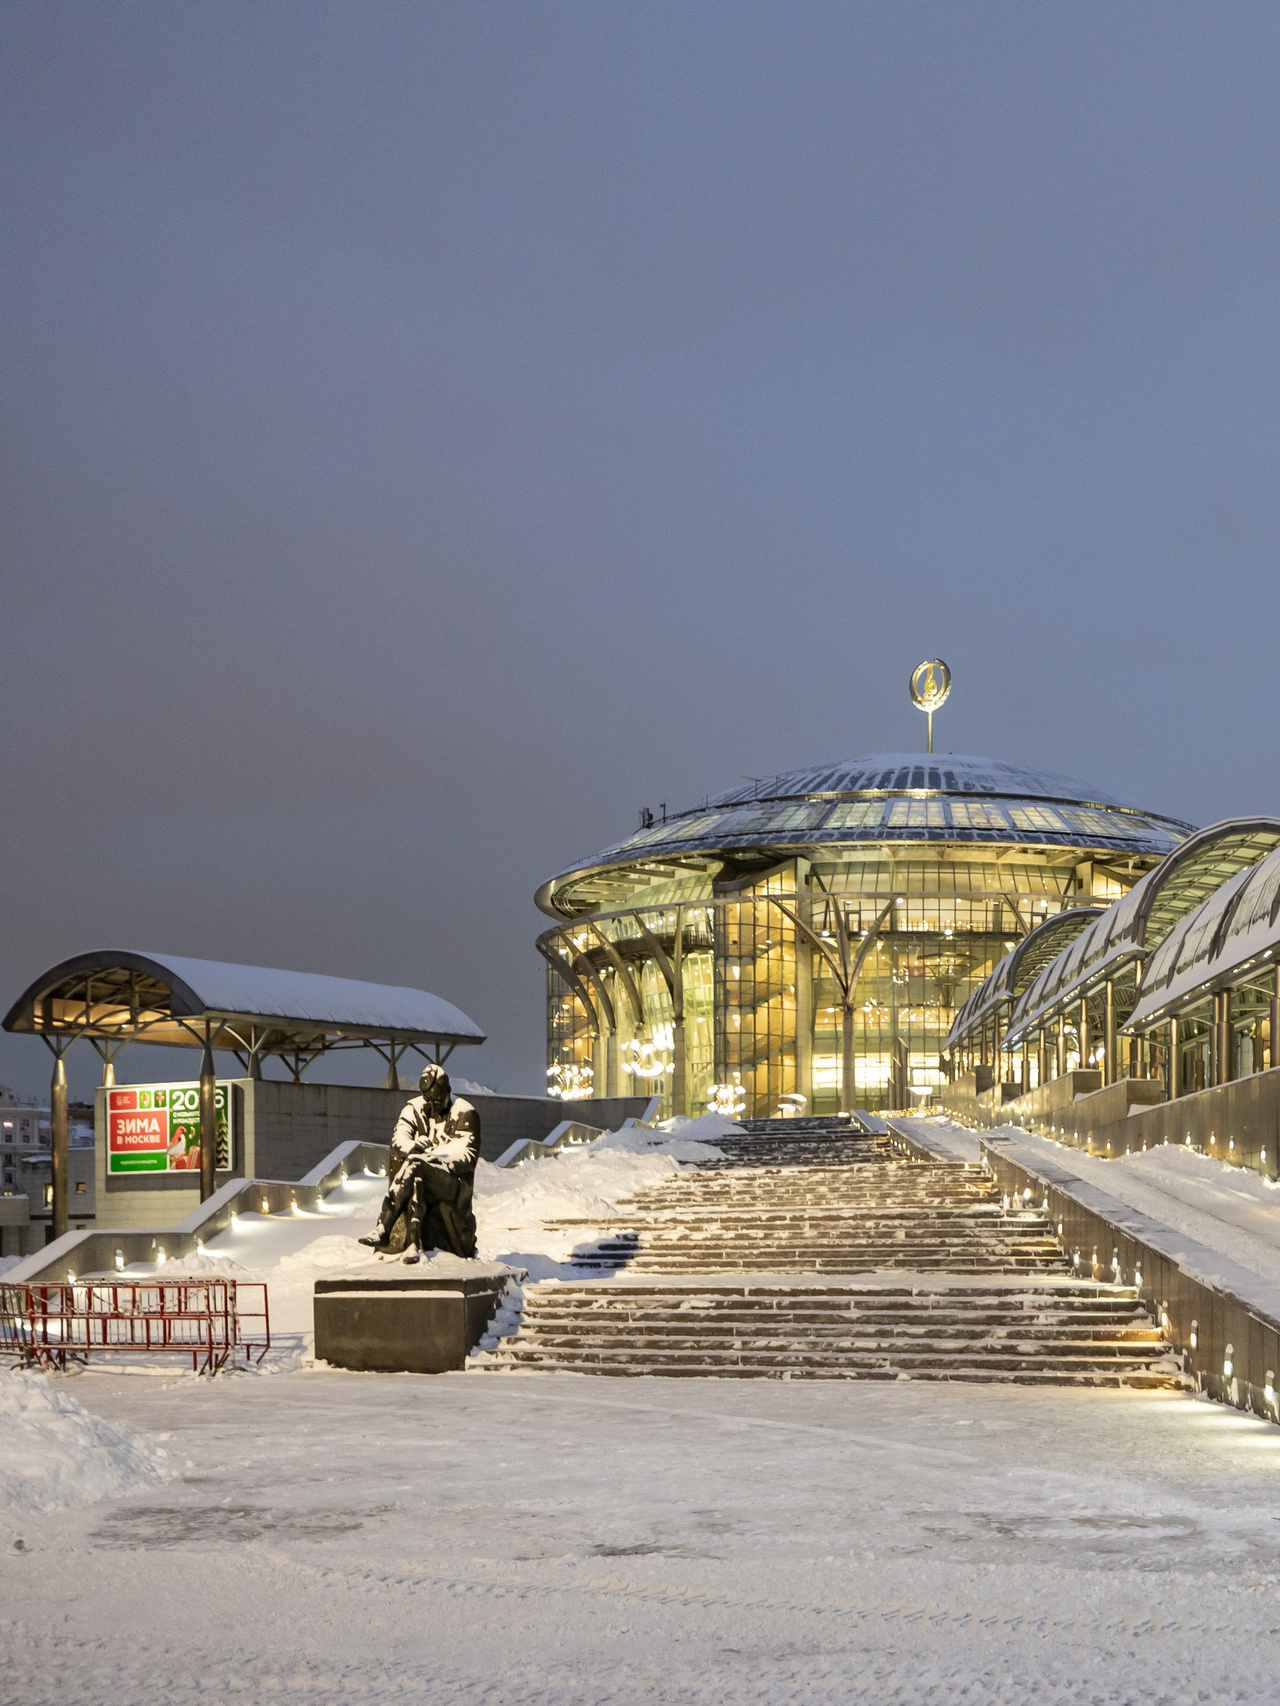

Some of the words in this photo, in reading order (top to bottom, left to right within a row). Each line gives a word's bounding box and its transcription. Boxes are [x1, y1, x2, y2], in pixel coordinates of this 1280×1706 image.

[172, 1089, 224, 1110] 206
[116, 1117, 160, 1135] ЗИМА
[116, 1135, 123, 1145] В
[125, 1135, 160, 1144] МОСКВЕ
